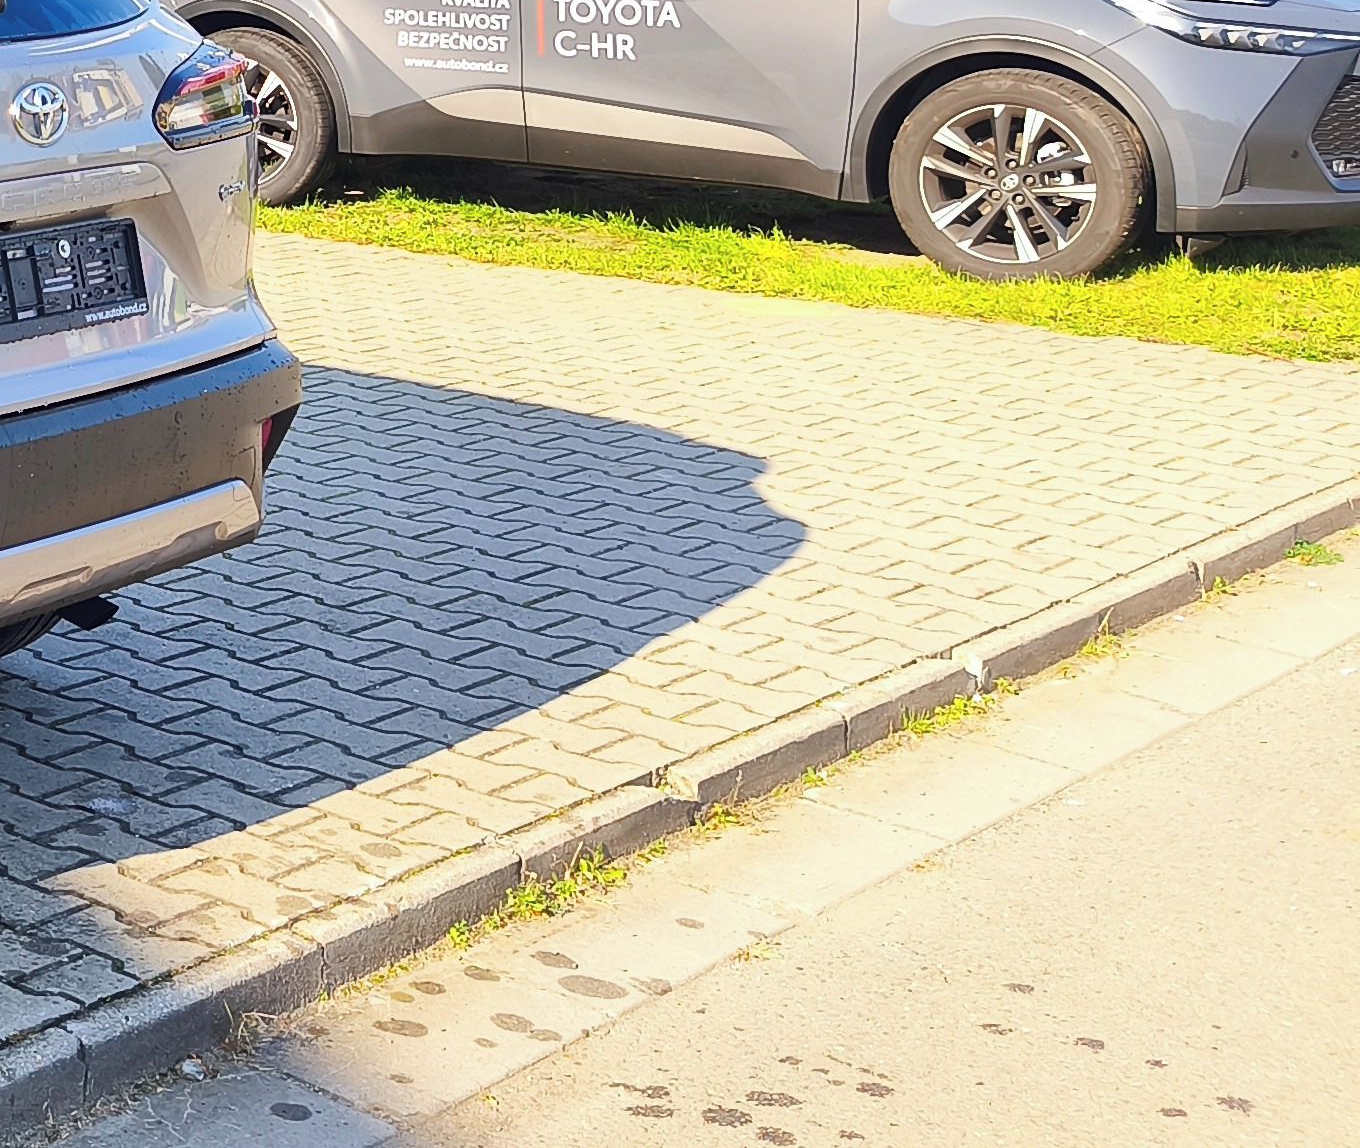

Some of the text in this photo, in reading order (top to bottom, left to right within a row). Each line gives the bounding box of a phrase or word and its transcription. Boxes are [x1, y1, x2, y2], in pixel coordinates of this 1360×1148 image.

[383, 8, 511, 31] SPOLEHLIVOST
[397, 30, 509, 52] BEZPEČNOST
[554, 30, 637, 61] C-HR
[403, 57, 509, 73] www.autobond.cz
[84, 302, 148, 323] www.autobond.cz
